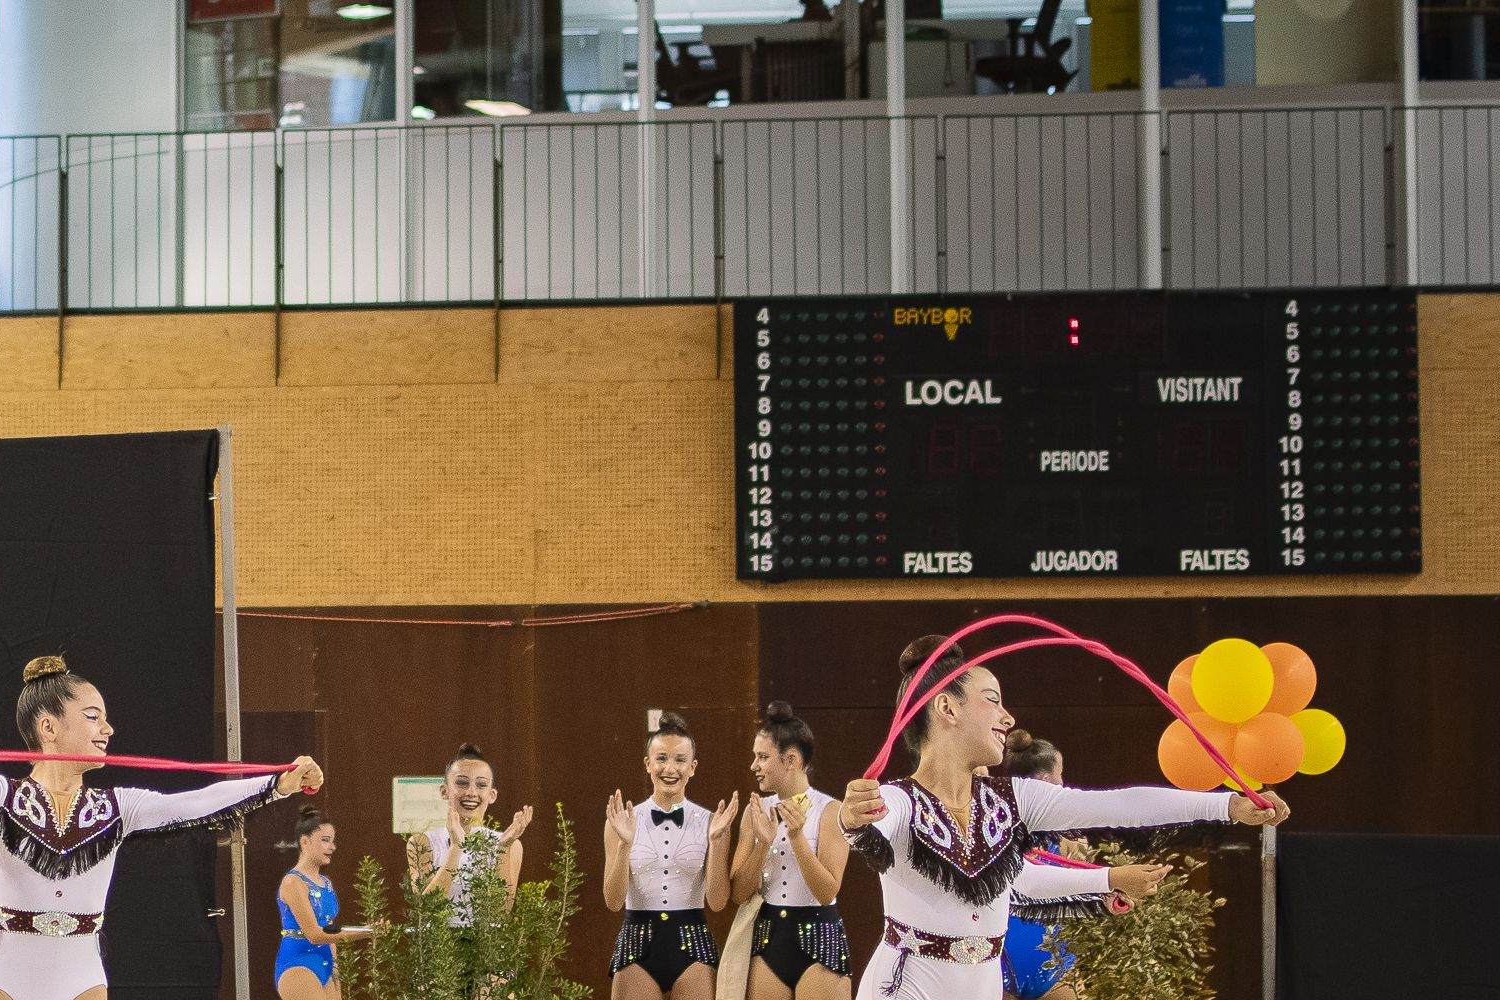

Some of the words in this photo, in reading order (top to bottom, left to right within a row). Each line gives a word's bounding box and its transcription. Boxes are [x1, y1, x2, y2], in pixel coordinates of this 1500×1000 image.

[757, 308, 771, 324] 4
[1285, 300, 1299, 317] 4
[757, 329, 771, 347] 5
[1286, 323, 1300, 340] 5
[757, 352, 771, 370] 6
[1286, 345, 1300, 363] 6
[757, 375, 771, 392] 7
[1287, 367, 1301, 385] 7
[905, 379, 1002, 406] LOCAL
[1157, 376, 1243, 403] VISITANT
[756, 397, 771, 415] 8
[1288, 390, 1302, 408] 8
[756, 419, 772, 437] 9
[1288, 412, 1302, 430] 9
[748, 441, 772, 459] 10
[1279, 435, 1303, 453] 10
[1040, 450, 1110, 472] PERIODE
[1279, 458, 1303, 476] 11
[748, 464, 772, 482] 11
[748, 486, 773, 504] 12
[1280, 481, 1304, 499] 12
[749, 509, 773, 527] 13
[1280, 503, 1305, 522] 13
[749, 531, 773, 550] 14
[1281, 526, 1305, 544] 14
[749, 554, 773, 572] 15
[903, 551, 973, 574] FALTES
[1030, 550, 1119, 572] JUGADOR
[1180, 548, 1250, 571] FALTES
[1281, 548, 1306, 566] 15
